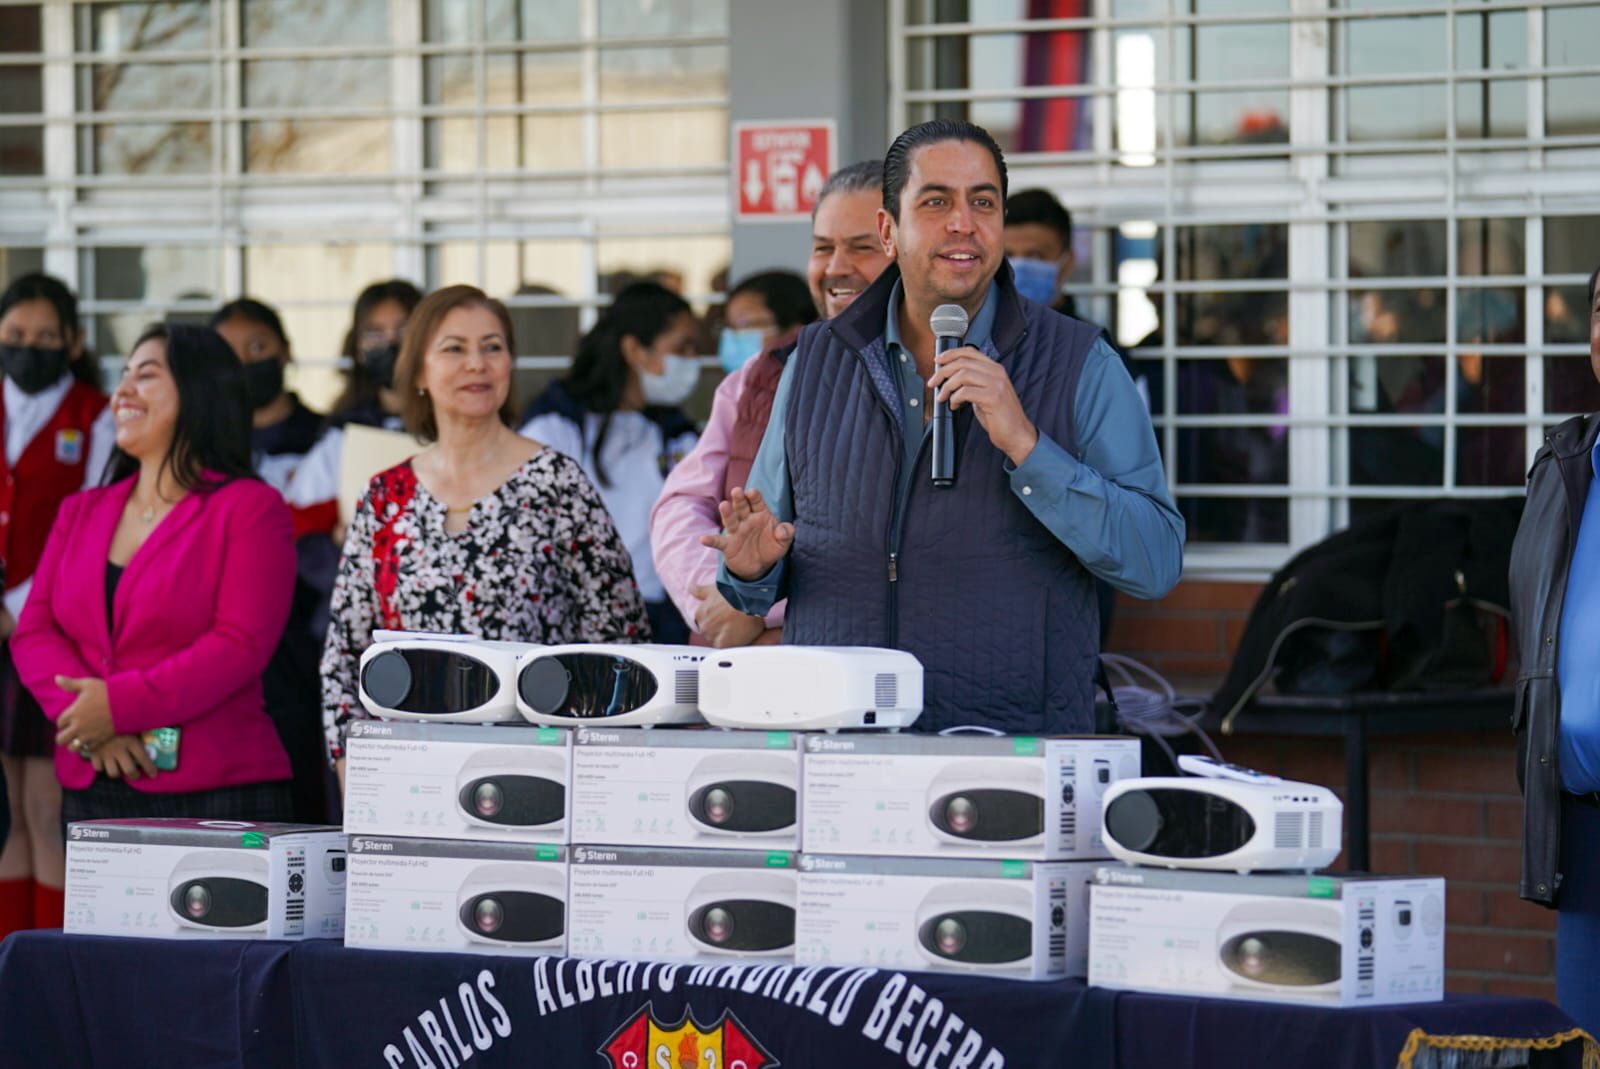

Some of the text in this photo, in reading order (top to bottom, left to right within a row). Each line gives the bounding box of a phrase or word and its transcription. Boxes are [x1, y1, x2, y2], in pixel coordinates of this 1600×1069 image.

[363, 724, 392, 735] Steren
[590, 731, 620, 742] Steren
[82, 828, 110, 839] Steren
[364, 840, 393, 851] Steren
[587, 850, 617, 861] Steren
